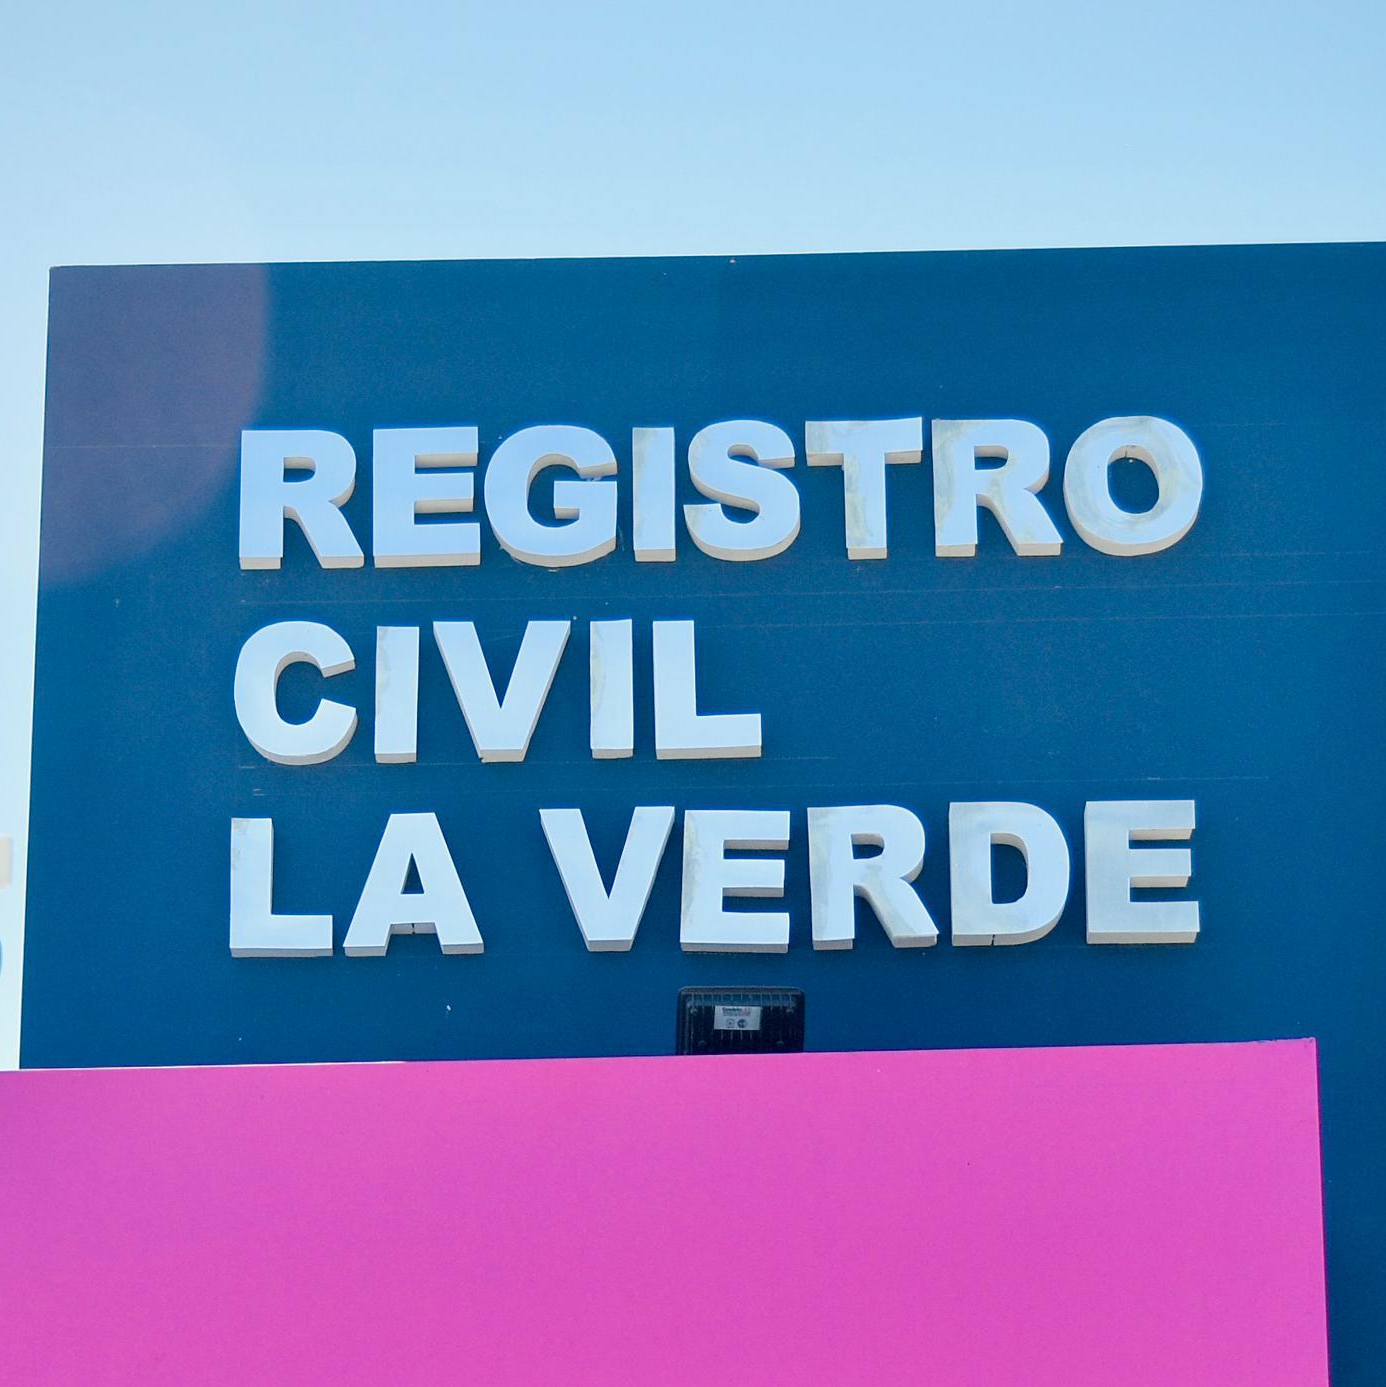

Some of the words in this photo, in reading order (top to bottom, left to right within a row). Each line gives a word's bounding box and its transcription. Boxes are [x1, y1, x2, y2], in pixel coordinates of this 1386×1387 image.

[238, 415, 1204, 570] REGISTRO
[233, 619, 763, 766] CIVIL
[229, 812, 484, 957] LA
[539, 800, 1201, 953] VERDE
